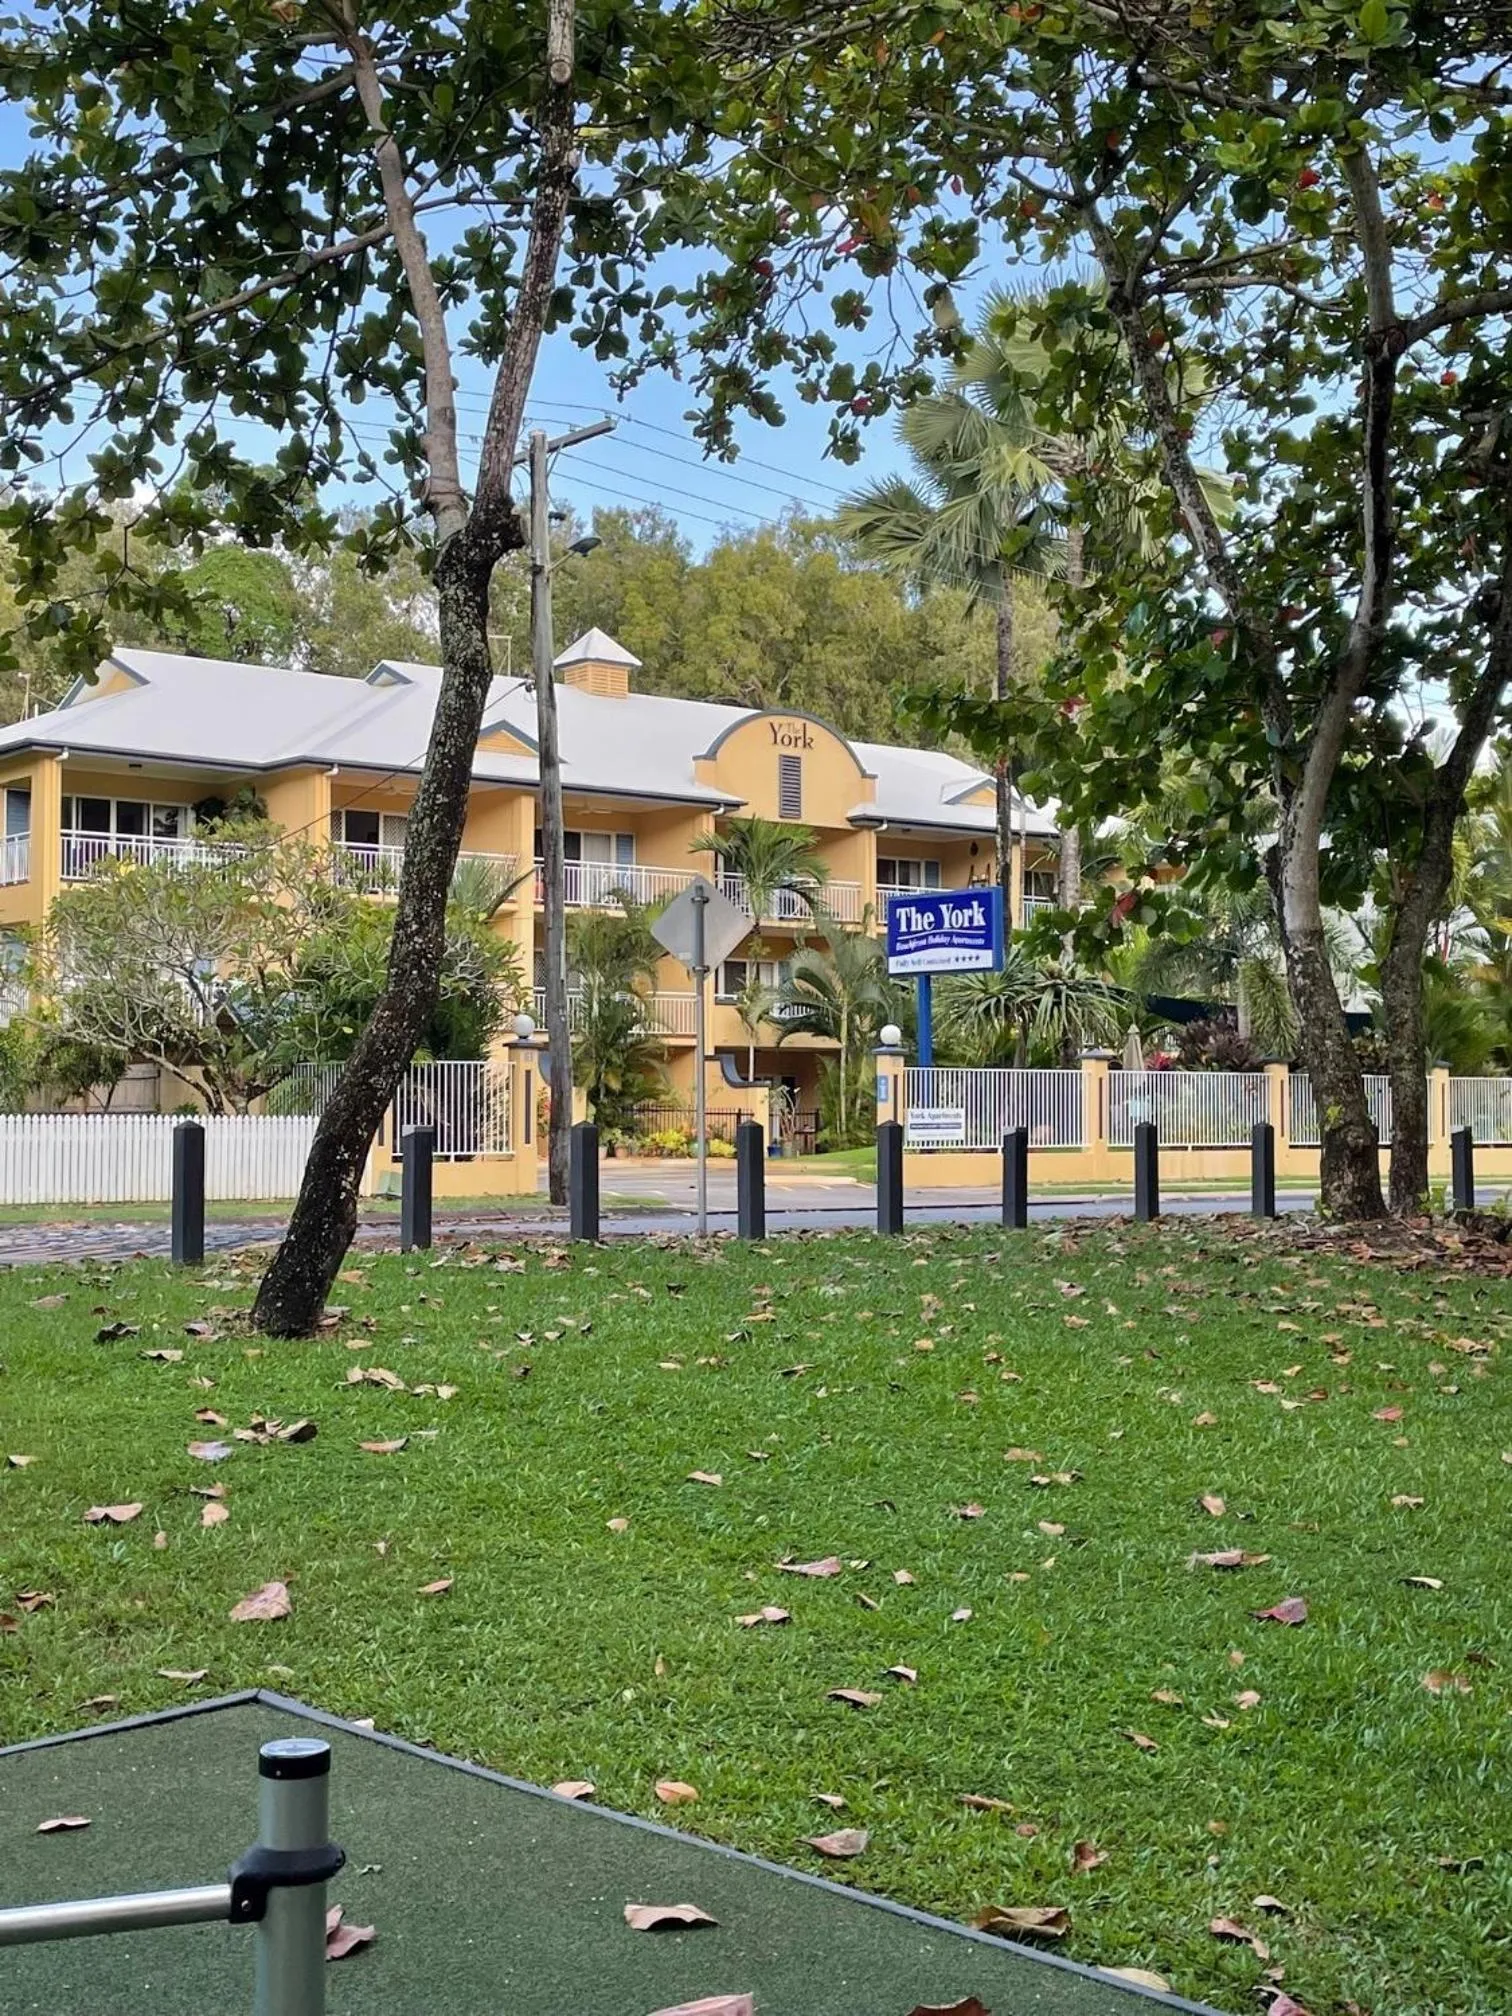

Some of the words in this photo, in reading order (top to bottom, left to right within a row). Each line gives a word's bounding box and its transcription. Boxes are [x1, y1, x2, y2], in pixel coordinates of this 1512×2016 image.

[769, 722, 814, 749] York
[896, 906, 935, 932] The
[939, 900, 986, 928] York
[928, 934, 951, 945] Holiday
[952, 935, 985, 945] Apartments
